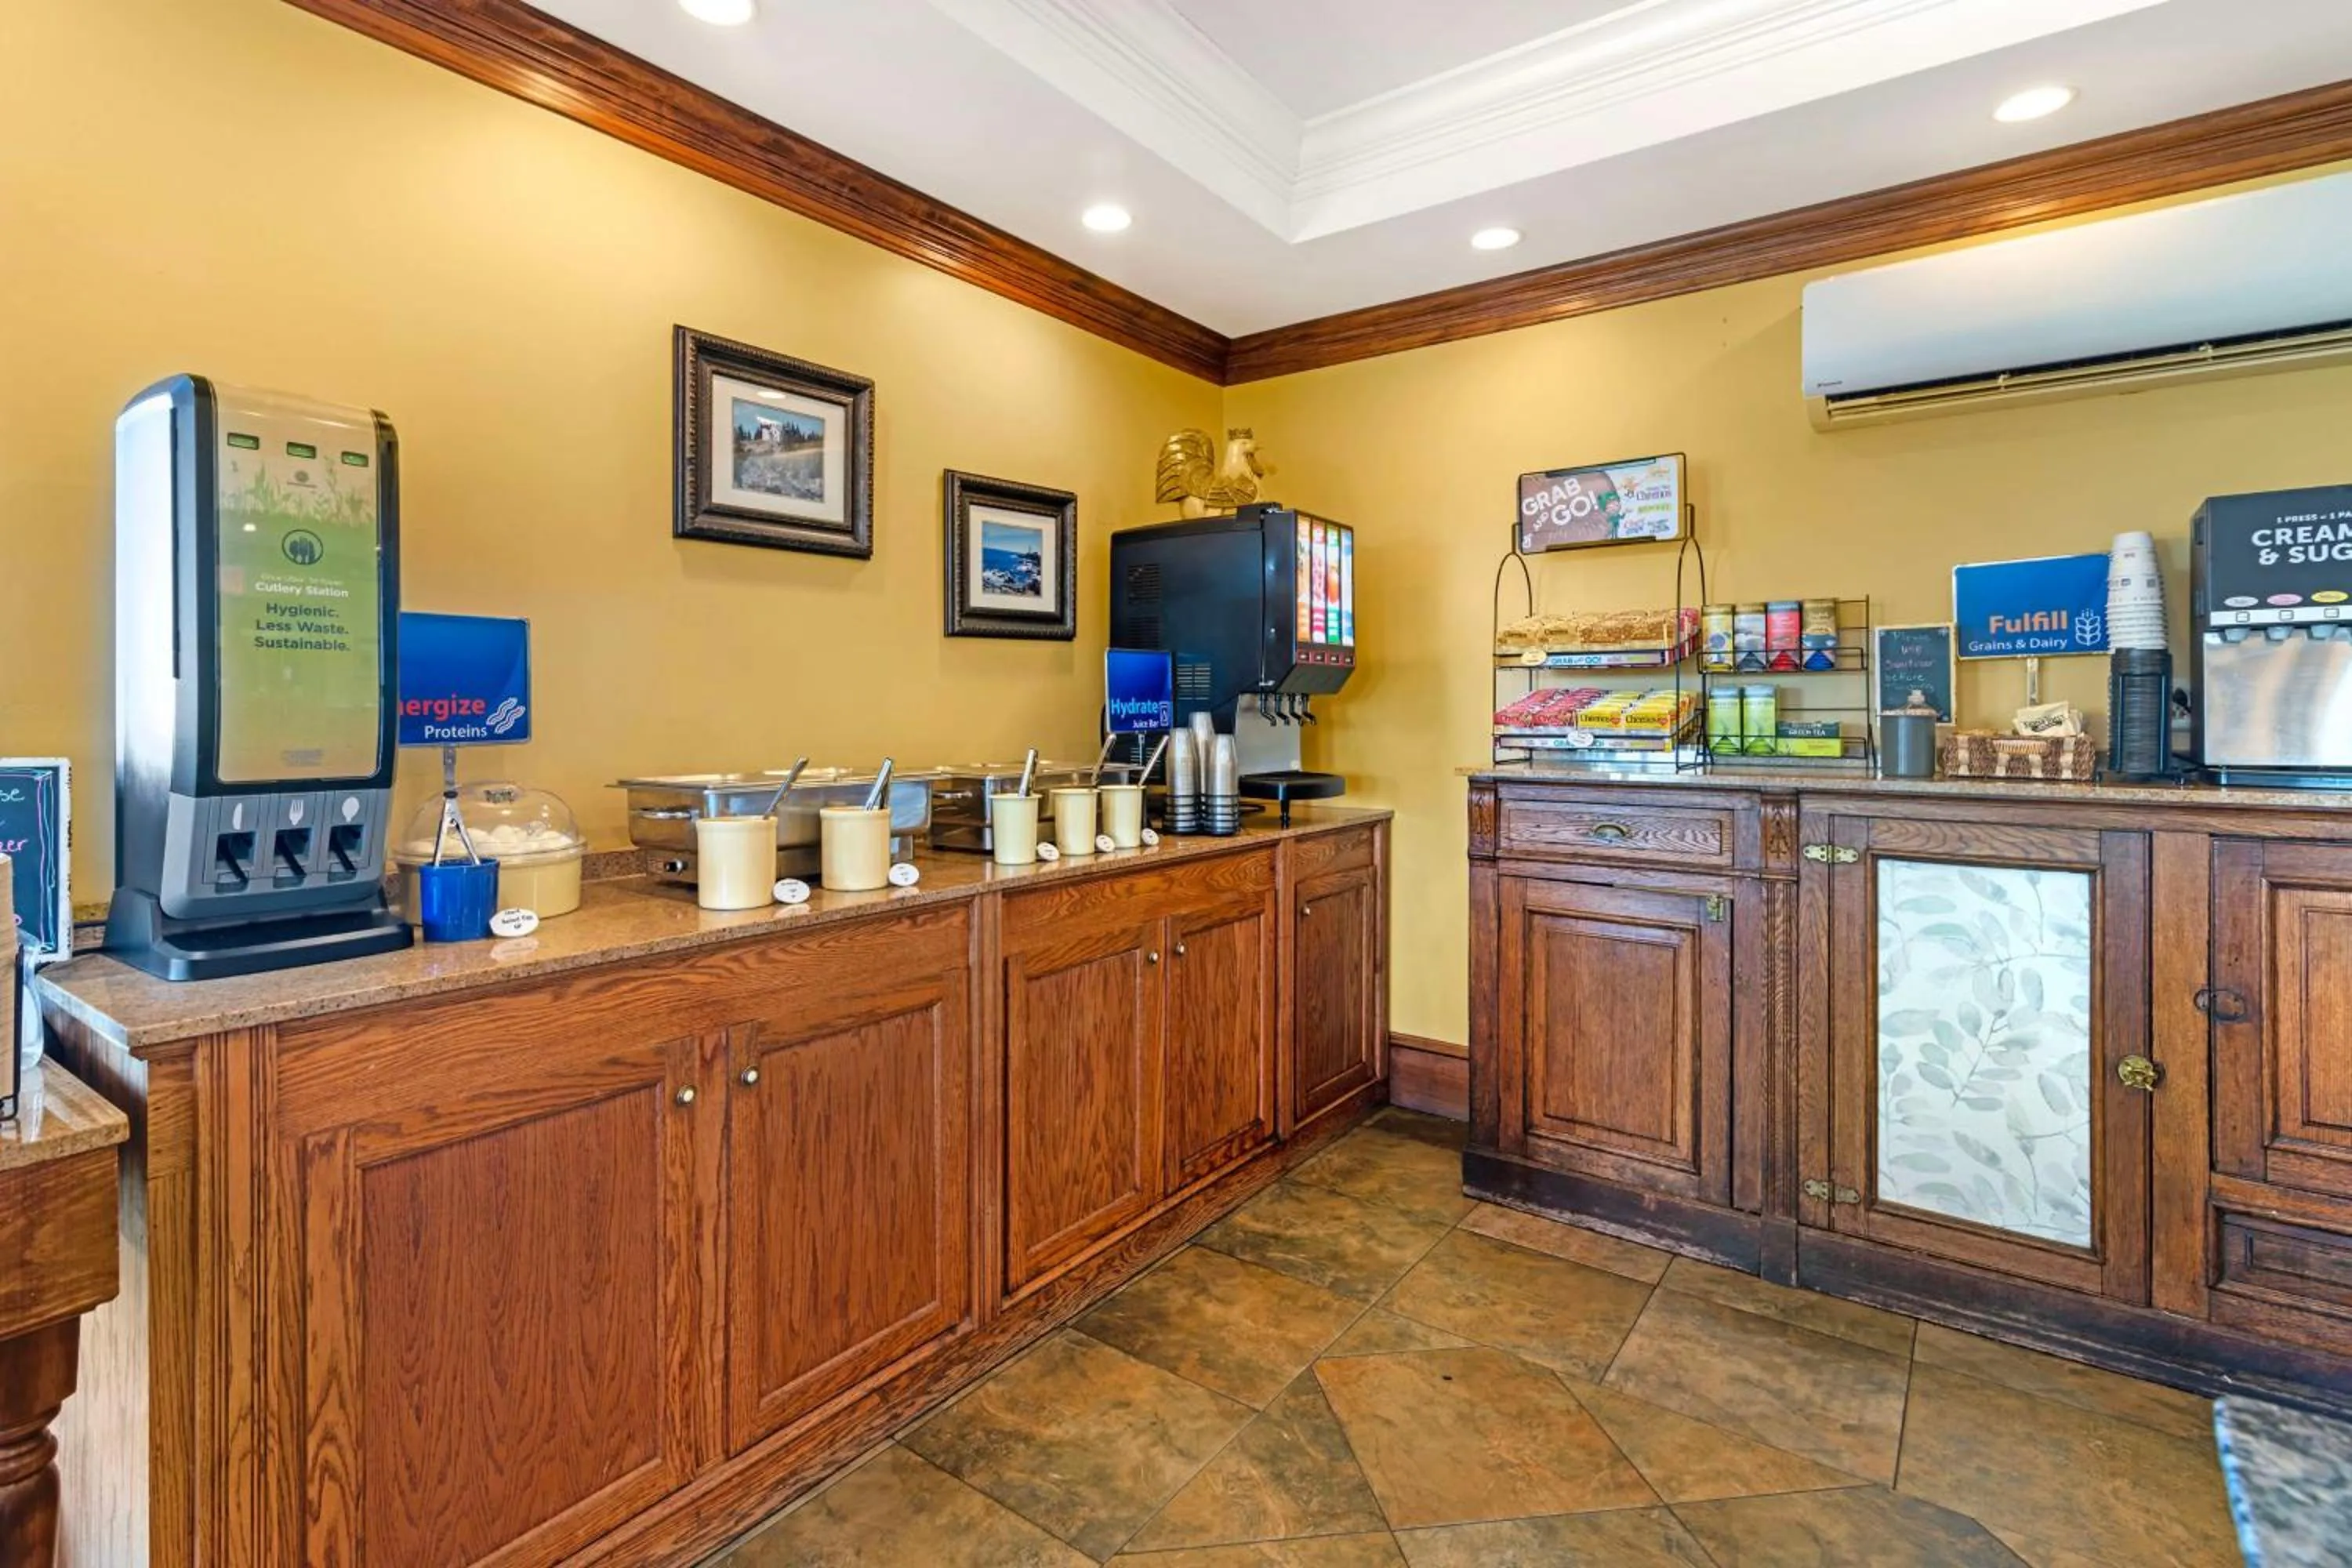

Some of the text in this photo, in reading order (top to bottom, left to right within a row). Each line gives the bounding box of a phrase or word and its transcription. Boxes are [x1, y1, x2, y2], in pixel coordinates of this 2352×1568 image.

[1522, 477, 1581, 516] GRAB
[1551, 489, 1599, 526] GO!
[2285, 514, 2318, 523] PRESS
[2259, 548, 2280, 565] &
[255, 582, 350, 598] Cutlery Station
[256, 619, 350, 635] Less Waste.
[1989, 610, 2067, 634] Fulfill
[254, 636, 352, 652] Sustainable.
[1969, 637, 2067, 652] Grains & Dairy
[1111, 697, 1158, 719] Hydrate
[424, 724, 488, 739] Proteins
